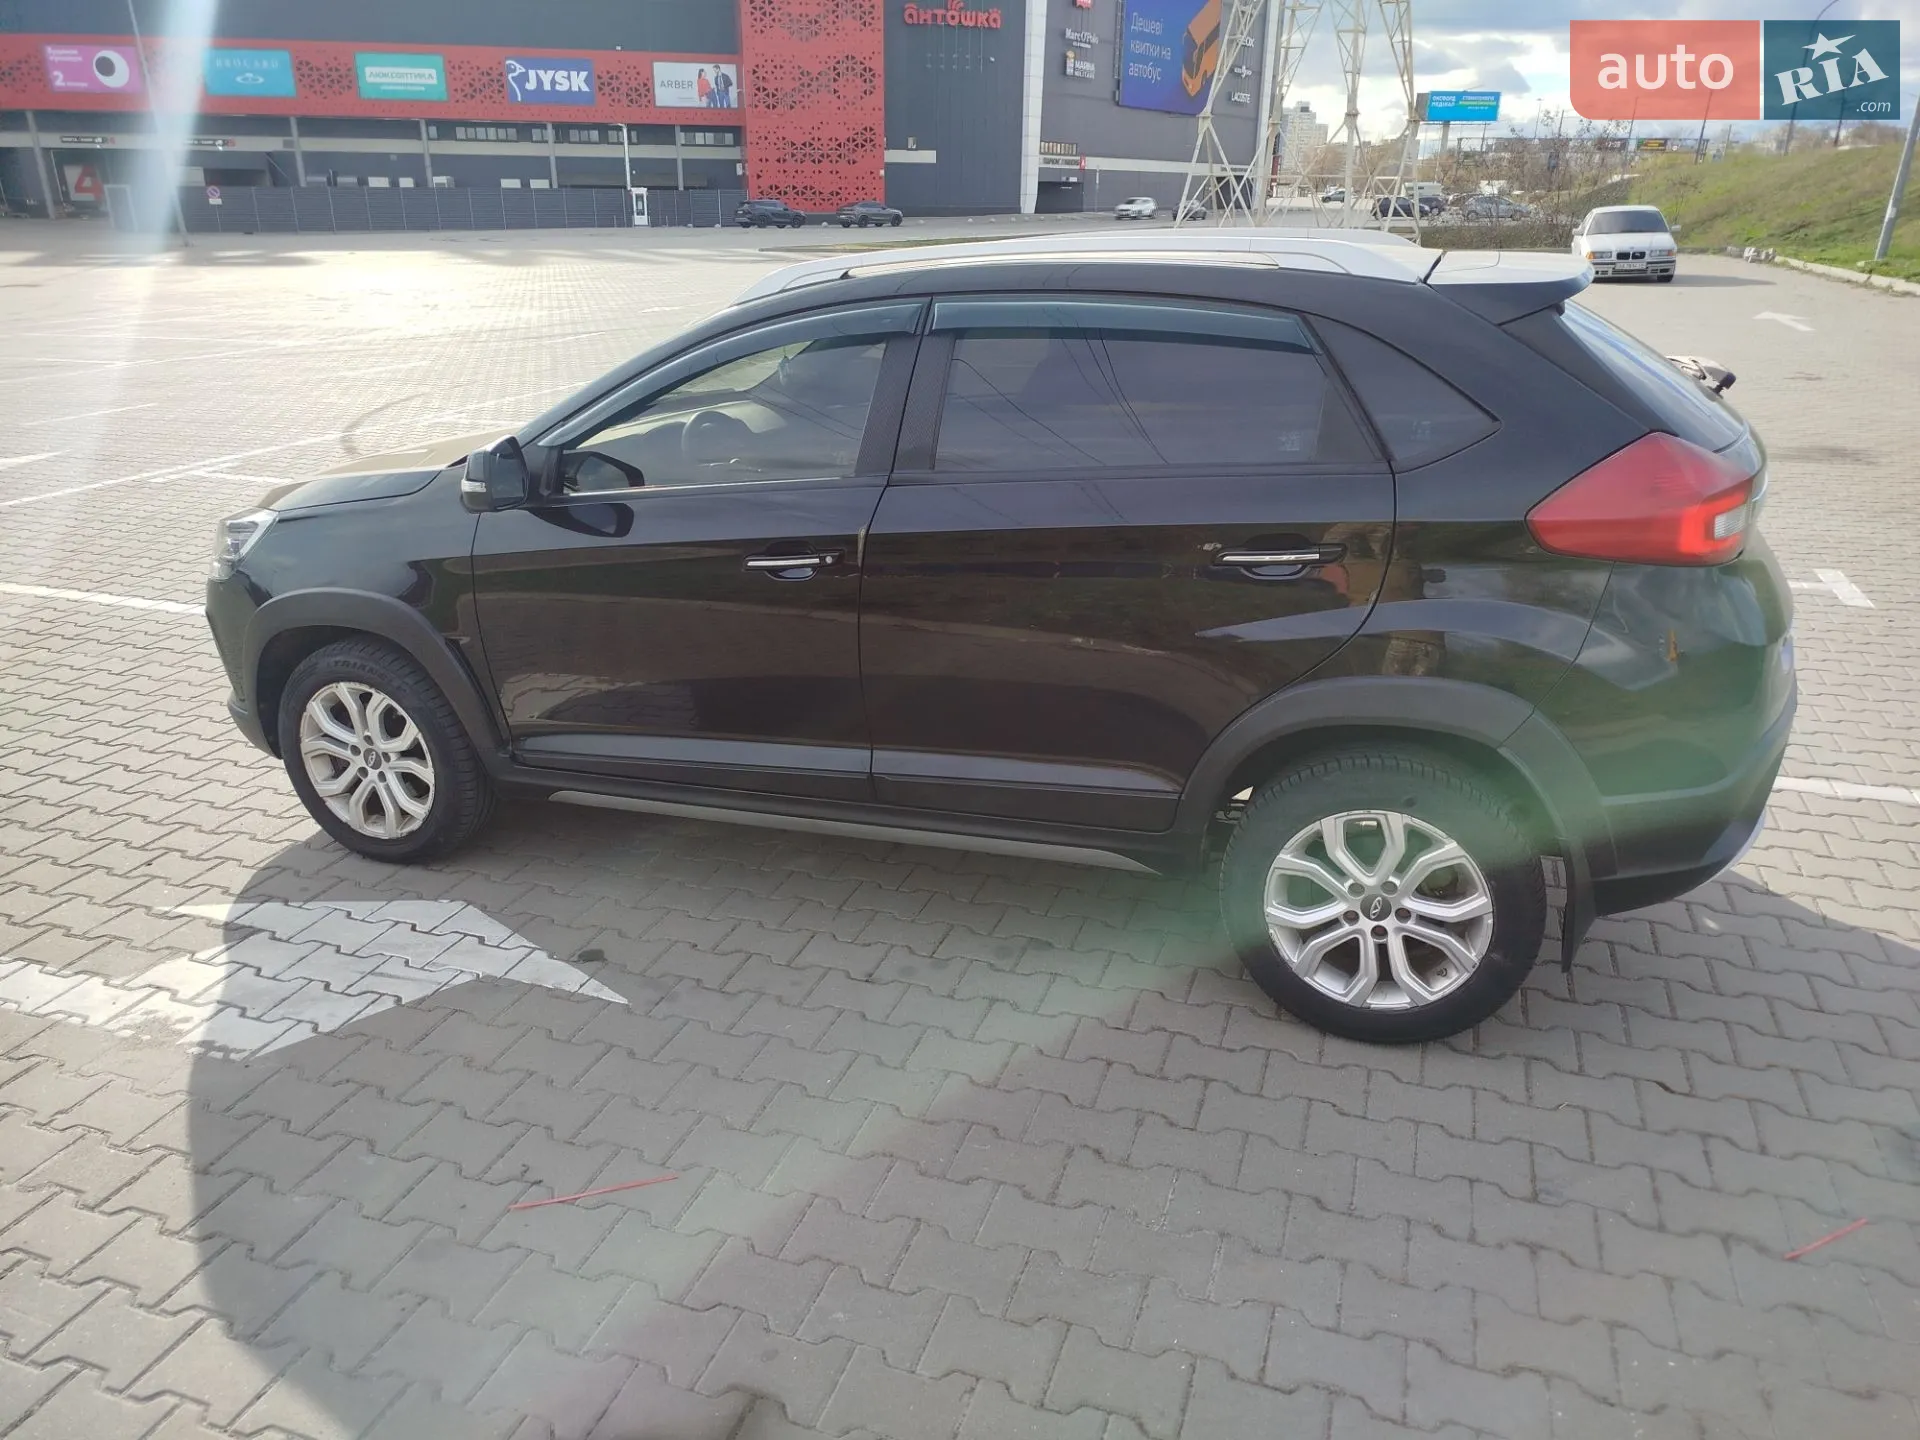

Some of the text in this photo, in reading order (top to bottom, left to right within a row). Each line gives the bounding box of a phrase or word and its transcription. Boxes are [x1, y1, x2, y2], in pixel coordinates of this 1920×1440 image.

[1131, 12, 1163, 35] Дешеві
[1130, 40, 1171, 60] квитки на
[52, 70, 66, 87] 2
[525, 69, 590, 92] JYSK
[1128, 62, 1162, 84] автобус
[660, 80, 693, 89] ARBER
